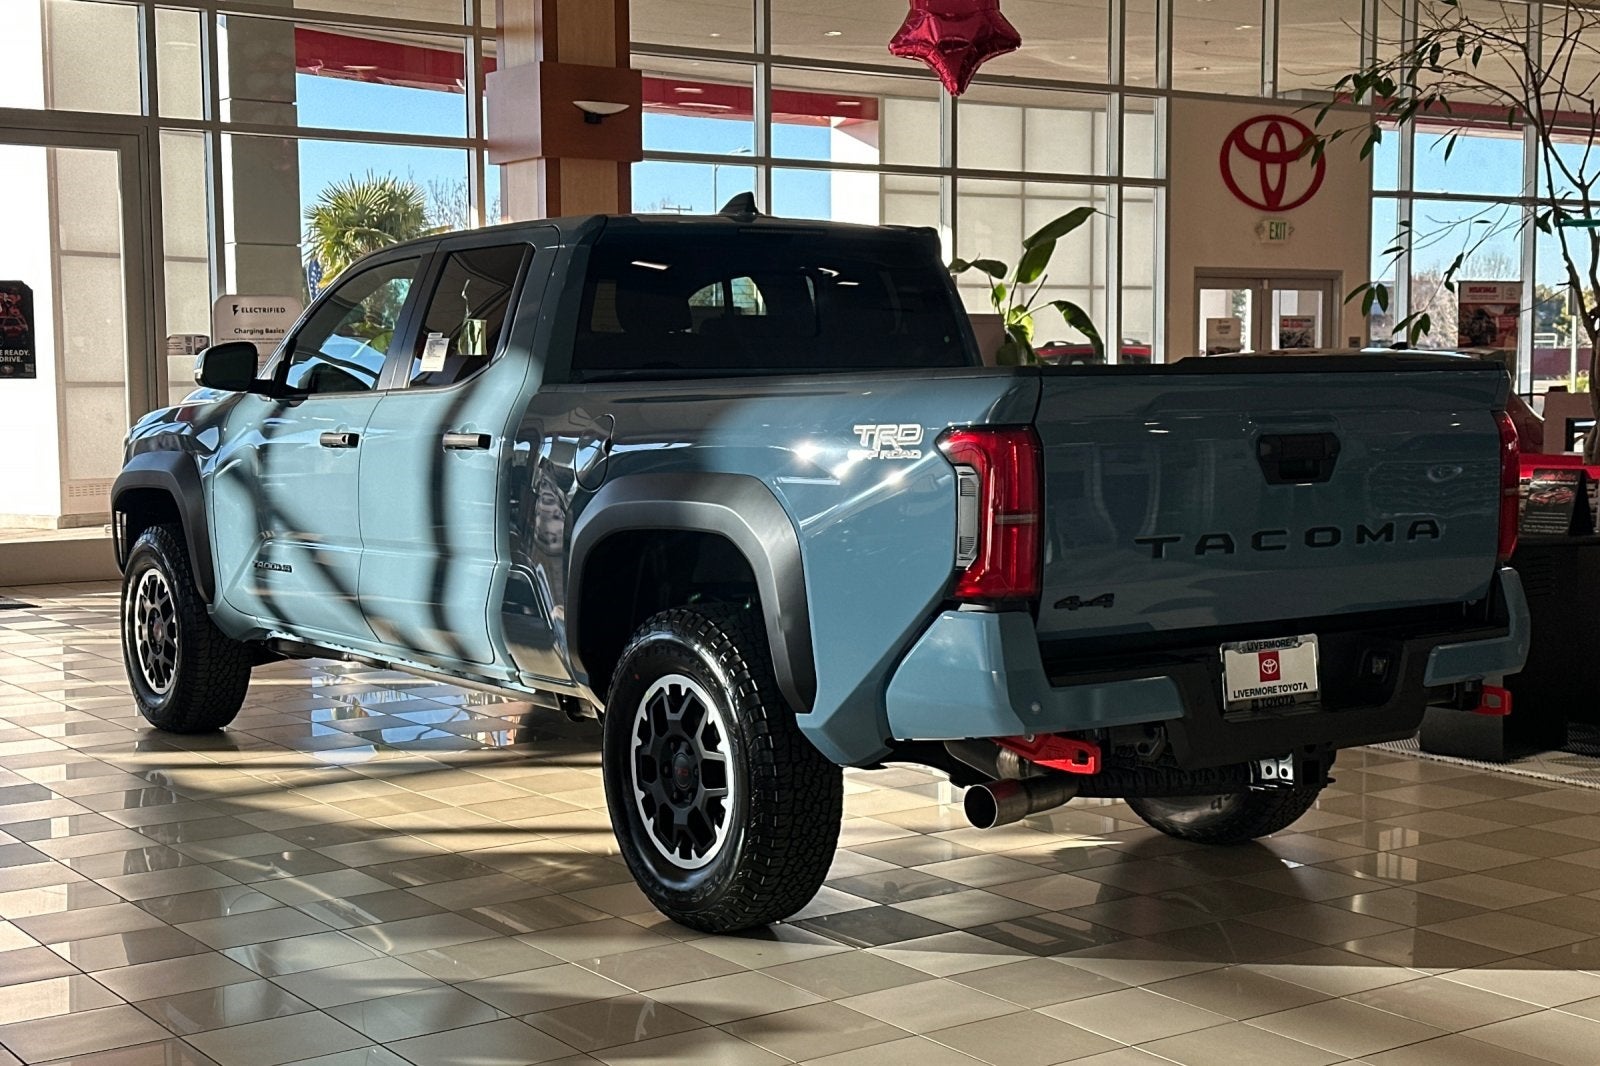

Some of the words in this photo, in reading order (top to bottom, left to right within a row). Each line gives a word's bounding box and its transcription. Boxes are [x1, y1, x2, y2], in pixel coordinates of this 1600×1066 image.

[1269, 221, 1287, 240] EXIT
[853, 424, 924, 451] TRD
[879, 449, 922, 460] ROAD
[1134, 519, 1440, 559] TACOMA
[1246, 639, 1292, 651] LIVERMORE
[1233, 686, 1278, 698] LIVERMORE
[1279, 682, 1309, 693] TOYOTA
[1260, 695, 1296, 708] TOYOTA
